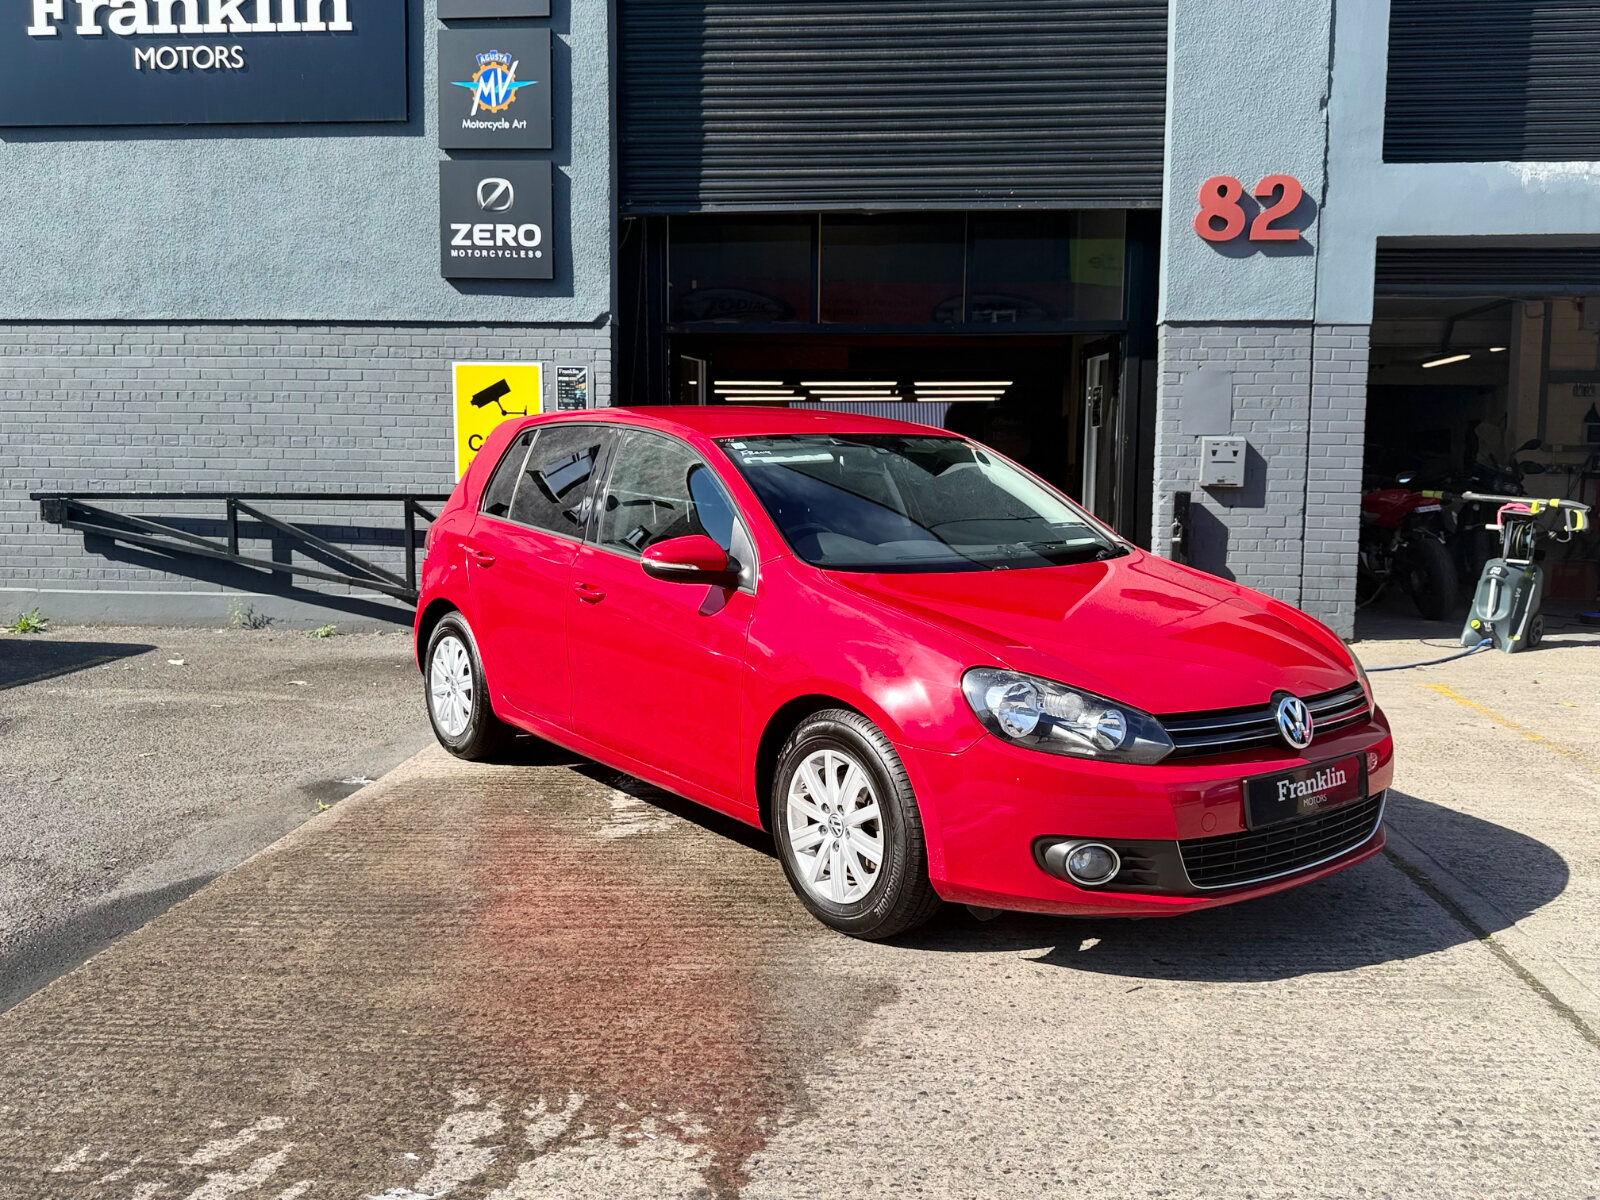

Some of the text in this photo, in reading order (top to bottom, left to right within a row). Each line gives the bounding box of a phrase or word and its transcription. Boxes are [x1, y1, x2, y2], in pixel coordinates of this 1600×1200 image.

[27, 0, 354, 37] Franklin
[134, 45, 245, 70] MOTORS
[480, 53, 508, 63] AGUSTA
[471, 60, 519, 117] MV
[462, 118, 527, 131] Motorcycle Art
[1193, 174, 1304, 243] 82
[450, 223, 542, 248] ZERO
[1277, 767, 1347, 802] Franklin
[1303, 793, 1328, 808] MOTORS
